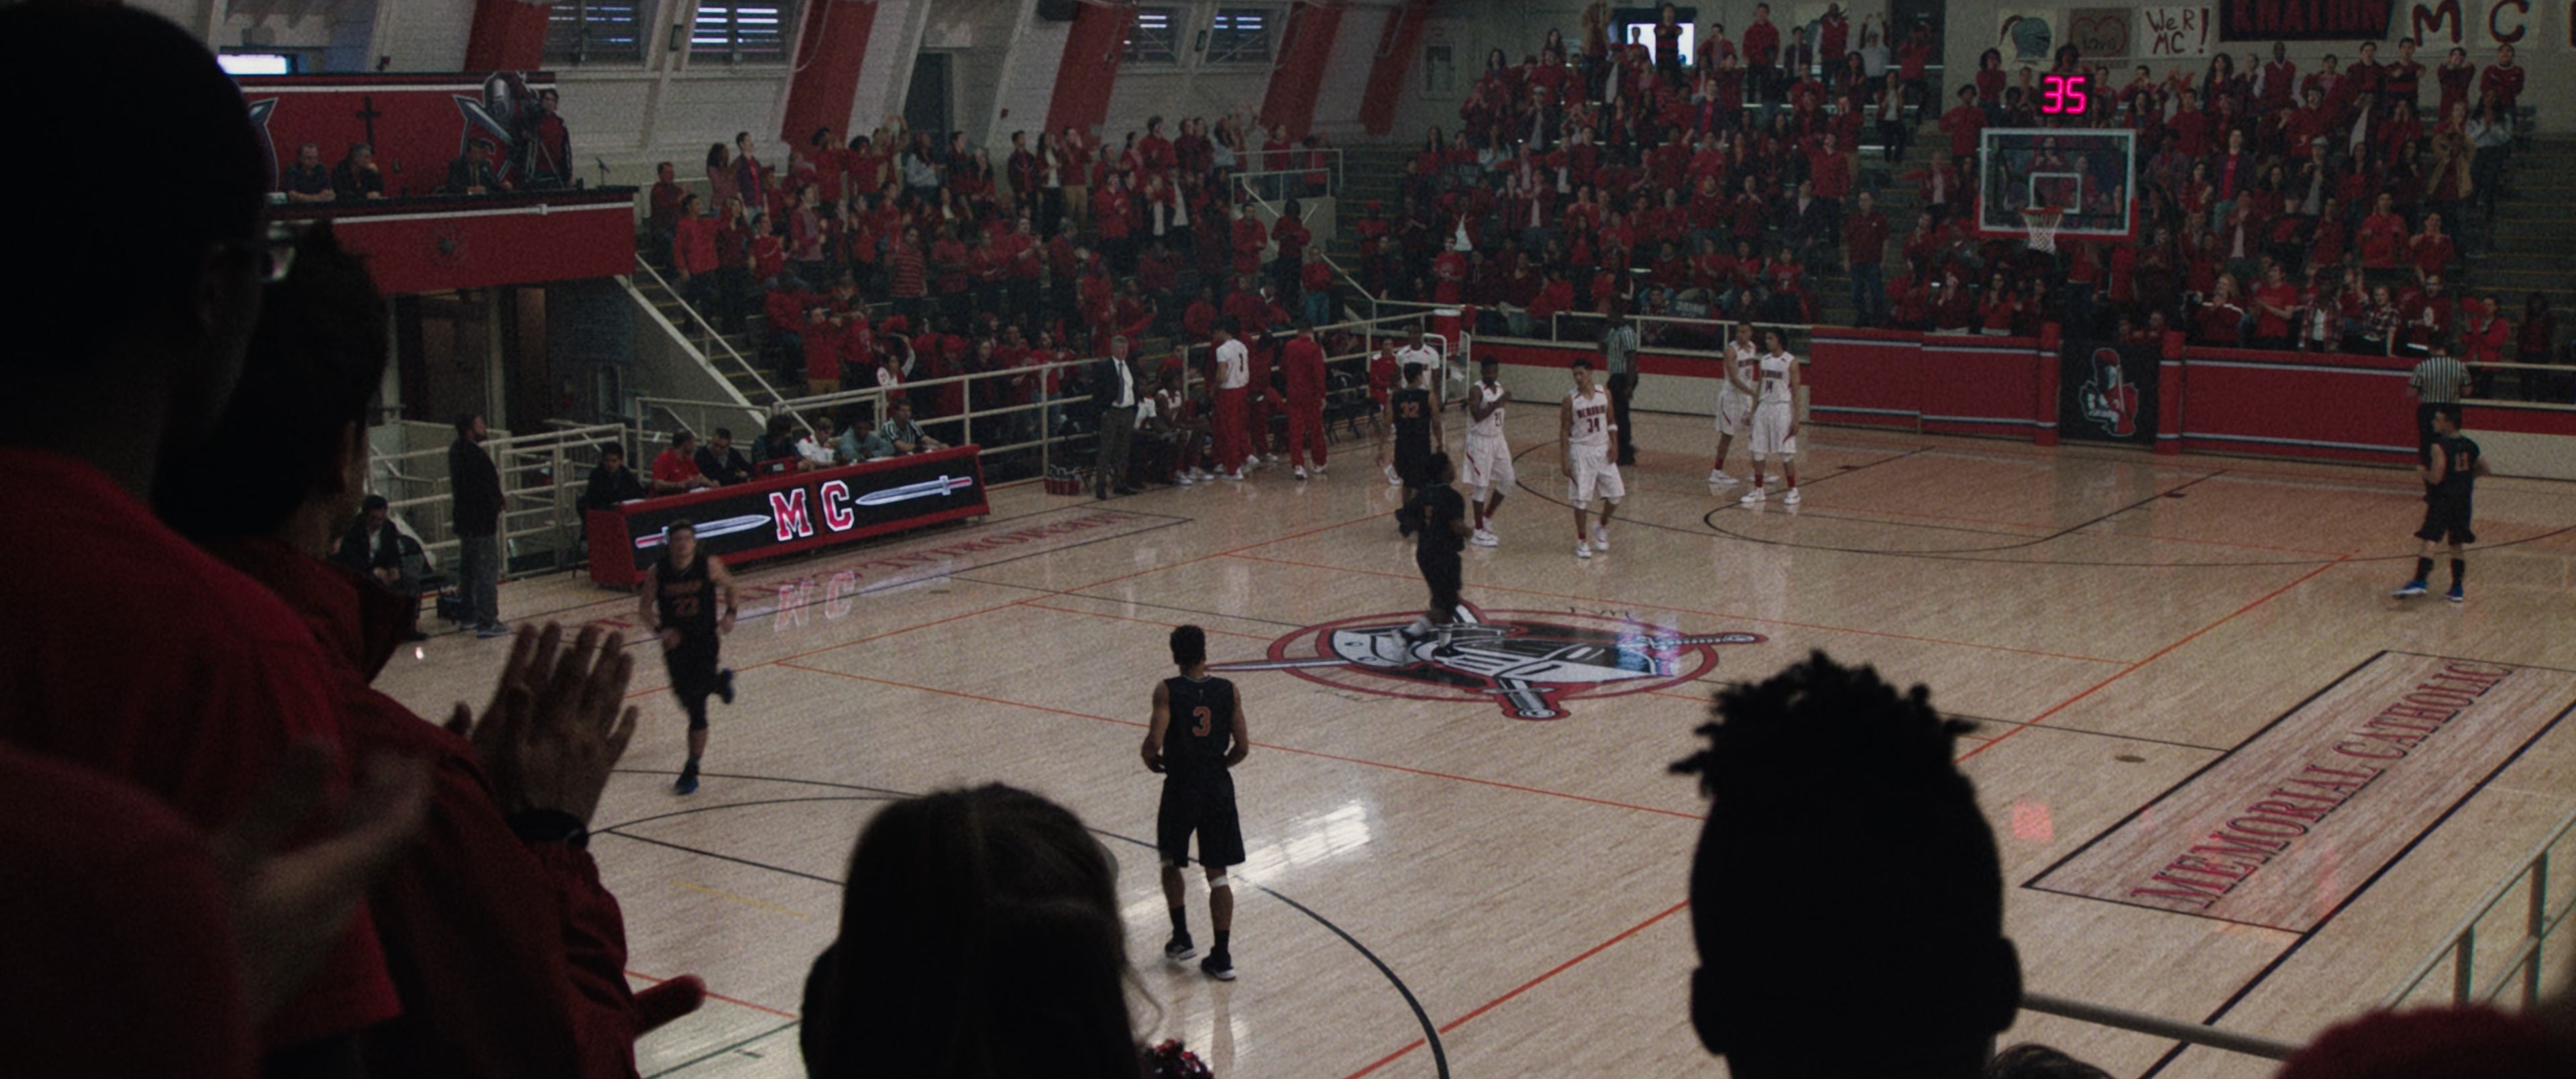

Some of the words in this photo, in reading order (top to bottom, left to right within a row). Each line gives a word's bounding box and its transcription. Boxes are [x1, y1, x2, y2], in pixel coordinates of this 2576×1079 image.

[2042, 75, 2087, 114] 35
[1192, 705, 1212, 737] 3
[2131, 764, 2386, 909] MEMORIAL
[2332, 660, 2514, 760] CATHOLIC
